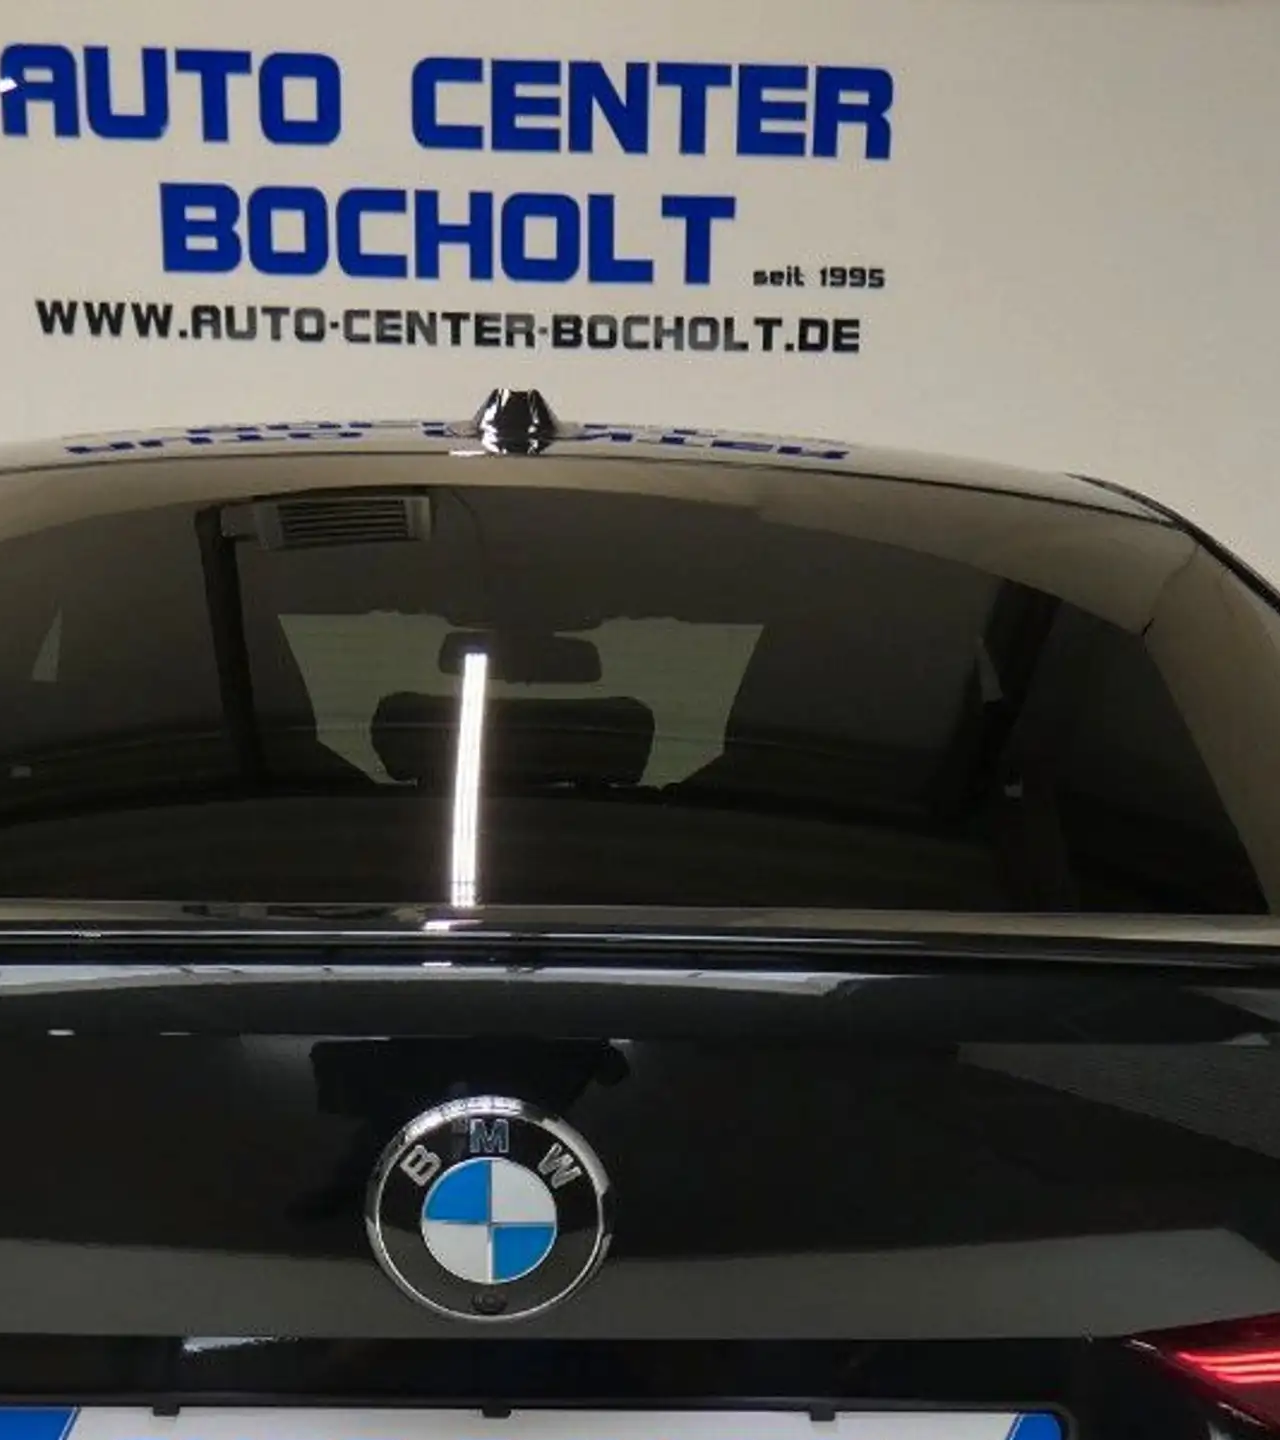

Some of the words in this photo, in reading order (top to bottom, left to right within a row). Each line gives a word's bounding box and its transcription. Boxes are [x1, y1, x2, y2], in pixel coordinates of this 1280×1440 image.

[0, 43, 342, 146] AUTO
[410, 56, 894, 160] CENTER
[160, 182, 737, 285] BOCHOLT
[752, 266, 806, 288] seit
[819, 267, 886, 290] 1995
[34, 299, 861, 354] WWW.AUTO-CENTER-BOCHOLT.DE
[400, 1117, 582, 1189] BMW
